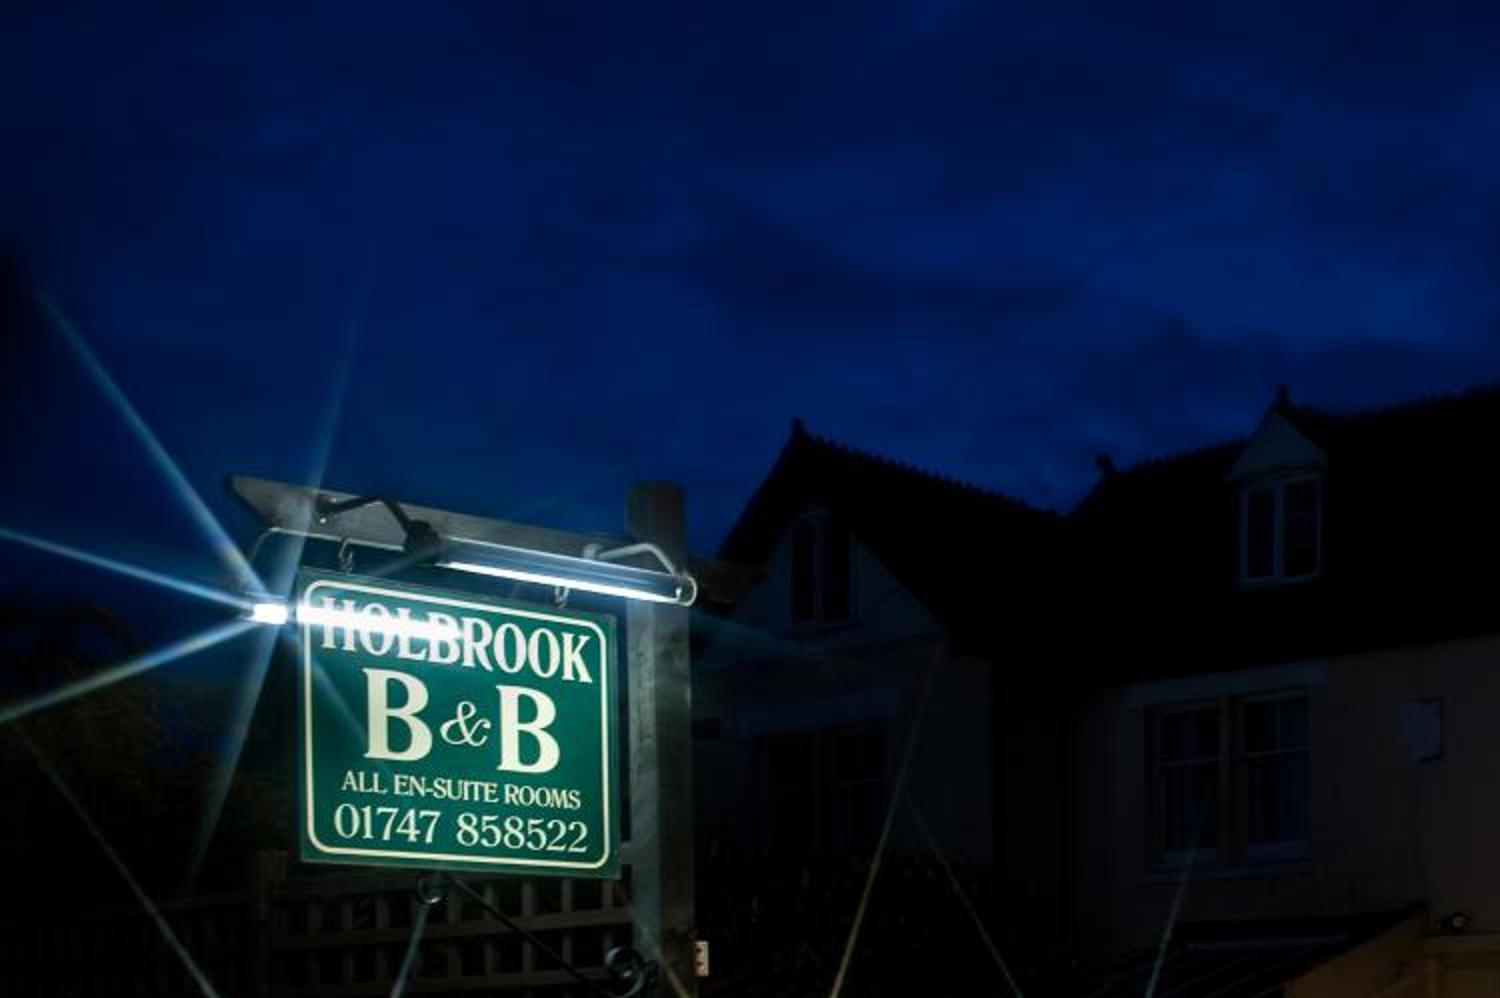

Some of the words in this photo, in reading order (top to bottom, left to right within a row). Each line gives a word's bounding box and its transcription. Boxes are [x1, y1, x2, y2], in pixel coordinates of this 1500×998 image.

[320, 597, 592, 683] HOLBROOK
[363, 668, 433, 761] B
[440, 701, 491, 747] &
[496, 686, 561, 774] B
[342, 770, 388, 794] ALL
[394, 776, 499, 803] EN-SUITE
[504, 784, 582, 810] ROOMS
[334, 803, 440, 843] 01747
[456, 813, 588, 854] 858522
